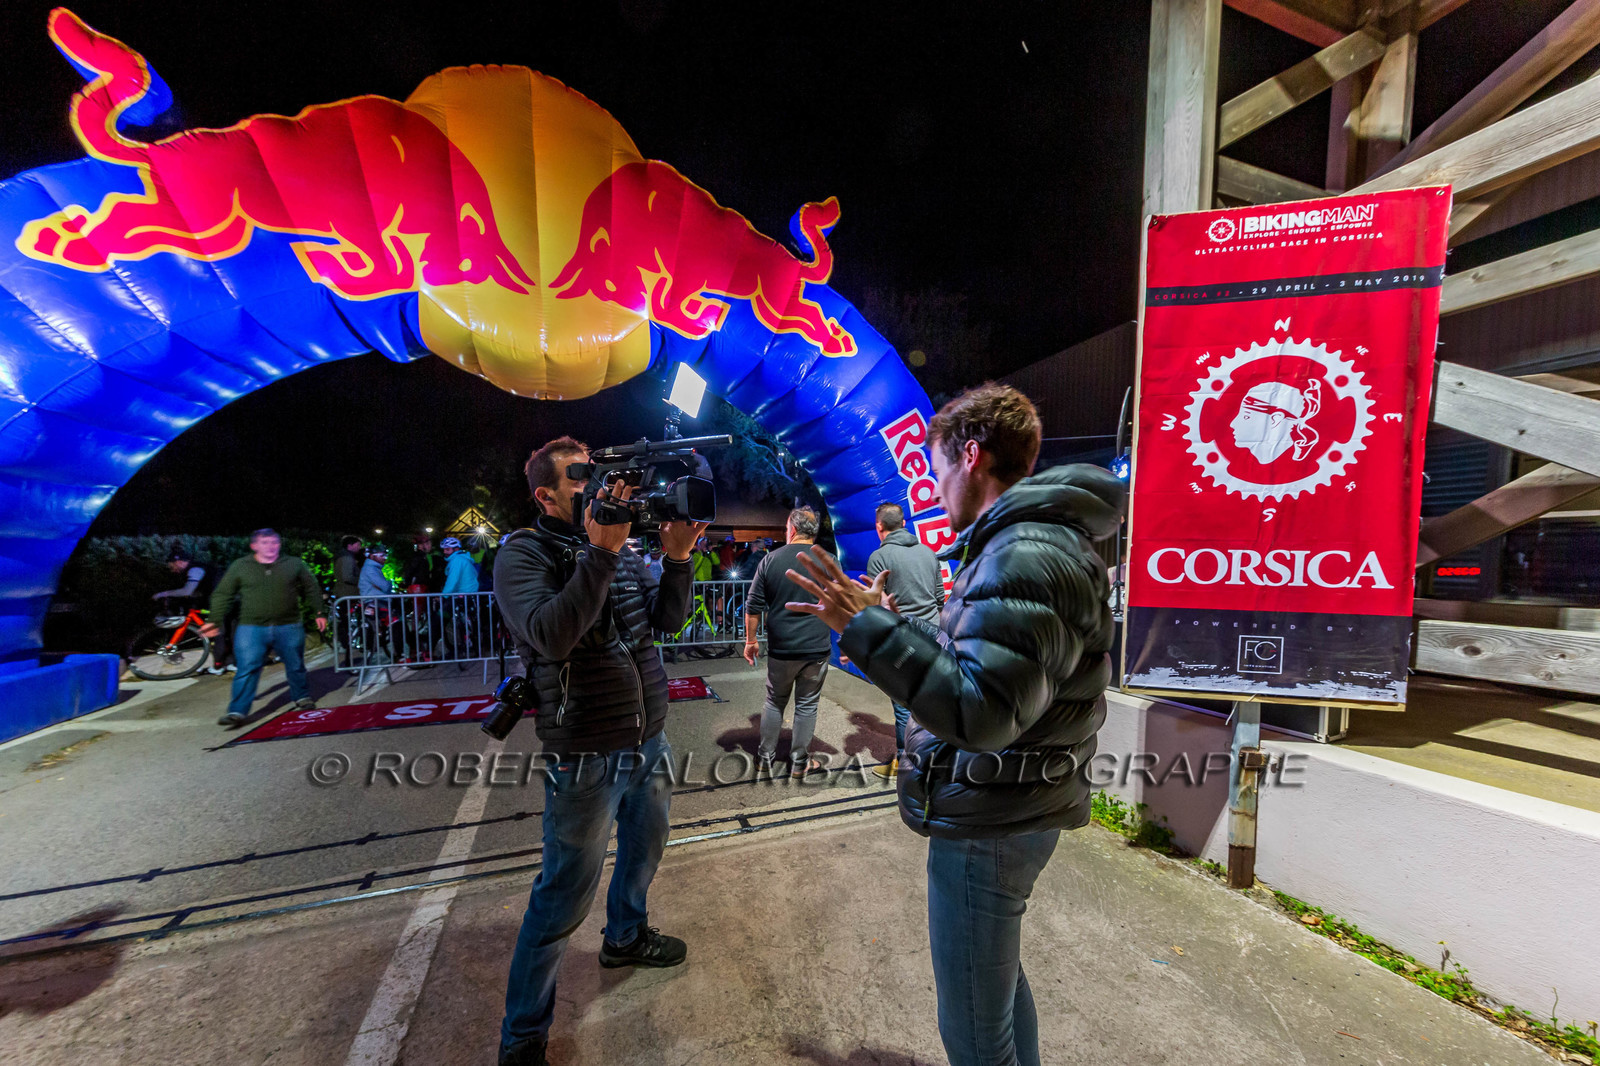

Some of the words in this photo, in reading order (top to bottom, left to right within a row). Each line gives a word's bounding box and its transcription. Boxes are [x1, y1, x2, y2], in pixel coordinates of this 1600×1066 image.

[1243, 204, 1375, 233] BIKINGMAN
[1243, 231, 1280, 240] EXPLORE
[1288, 226, 1321, 236] ENDURE
[1330, 221, 1373, 231] EMPOWER
[1195, 242, 1276, 256] ULTRACYCLING
[1281, 239, 1309, 248] RACE
[1333, 232, 1384, 242] CORSICA
[1155, 291, 1208, 301] CORSICA
[1252, 287, 1267, 295] 29
[1276, 283, 1316, 292] APRIL
[1355, 278, 1382, 287] MAY
[1393, 275, 1425, 283] 2019
[1274, 317, 1291, 332] N
[1160, 413, 1178, 431] W
[1383, 412, 1403, 423] E
[1262, 508, 1277, 522] S
[1147, 548, 1395, 589] CORSICA
[1175, 619, 1296, 630] POWERED
[1327, 625, 1353, 633] BY
